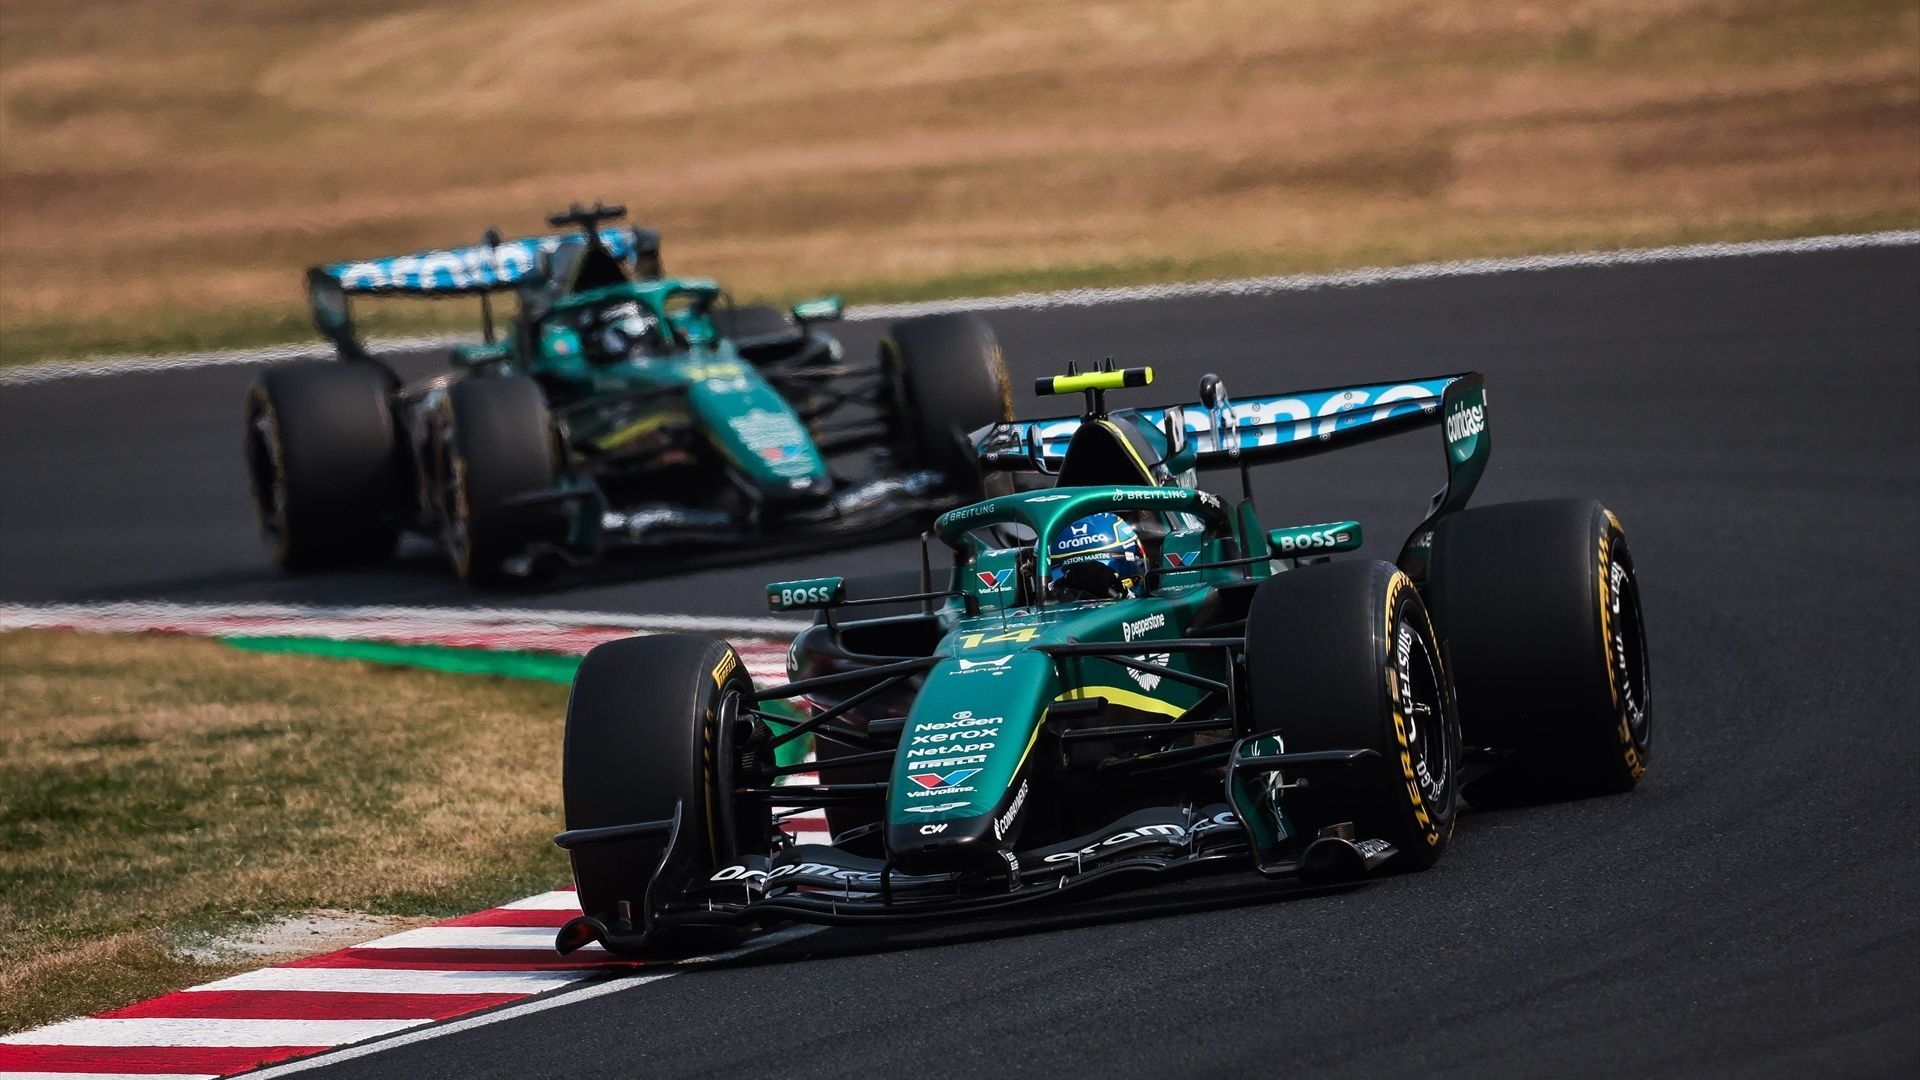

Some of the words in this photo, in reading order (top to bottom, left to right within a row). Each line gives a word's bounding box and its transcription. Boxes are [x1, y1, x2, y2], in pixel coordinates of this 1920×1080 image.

[1042, 384, 1437, 457] aamco
[1127, 489, 1187, 501] BREITLING
[950, 503, 995, 520] BREITLING
[1058, 533, 1108, 549] aramco
[1280, 530, 1336, 552] BOSS
[1063, 555, 1084, 565] ASTON
[1084, 552, 1110, 561] MARTIN
[782, 586, 830, 605] BOSS
[978, 586, 1012, 594] Valoine
[1131, 613, 1165, 640] pepperstone
[960, 627, 1040, 648] 14
[711, 649, 737, 690] PIRELLI
[915, 717, 1003, 732] NexGen
[911, 728, 998, 745] xerox
[907, 742, 995, 758] NetApp
[908, 755, 987, 770] PIRELLI
[1393, 711, 1430, 830] ZERO
[907, 786, 974, 797] Valvoline
[1043, 811, 1240, 862] aramco
[710, 862, 894, 883] aramco
